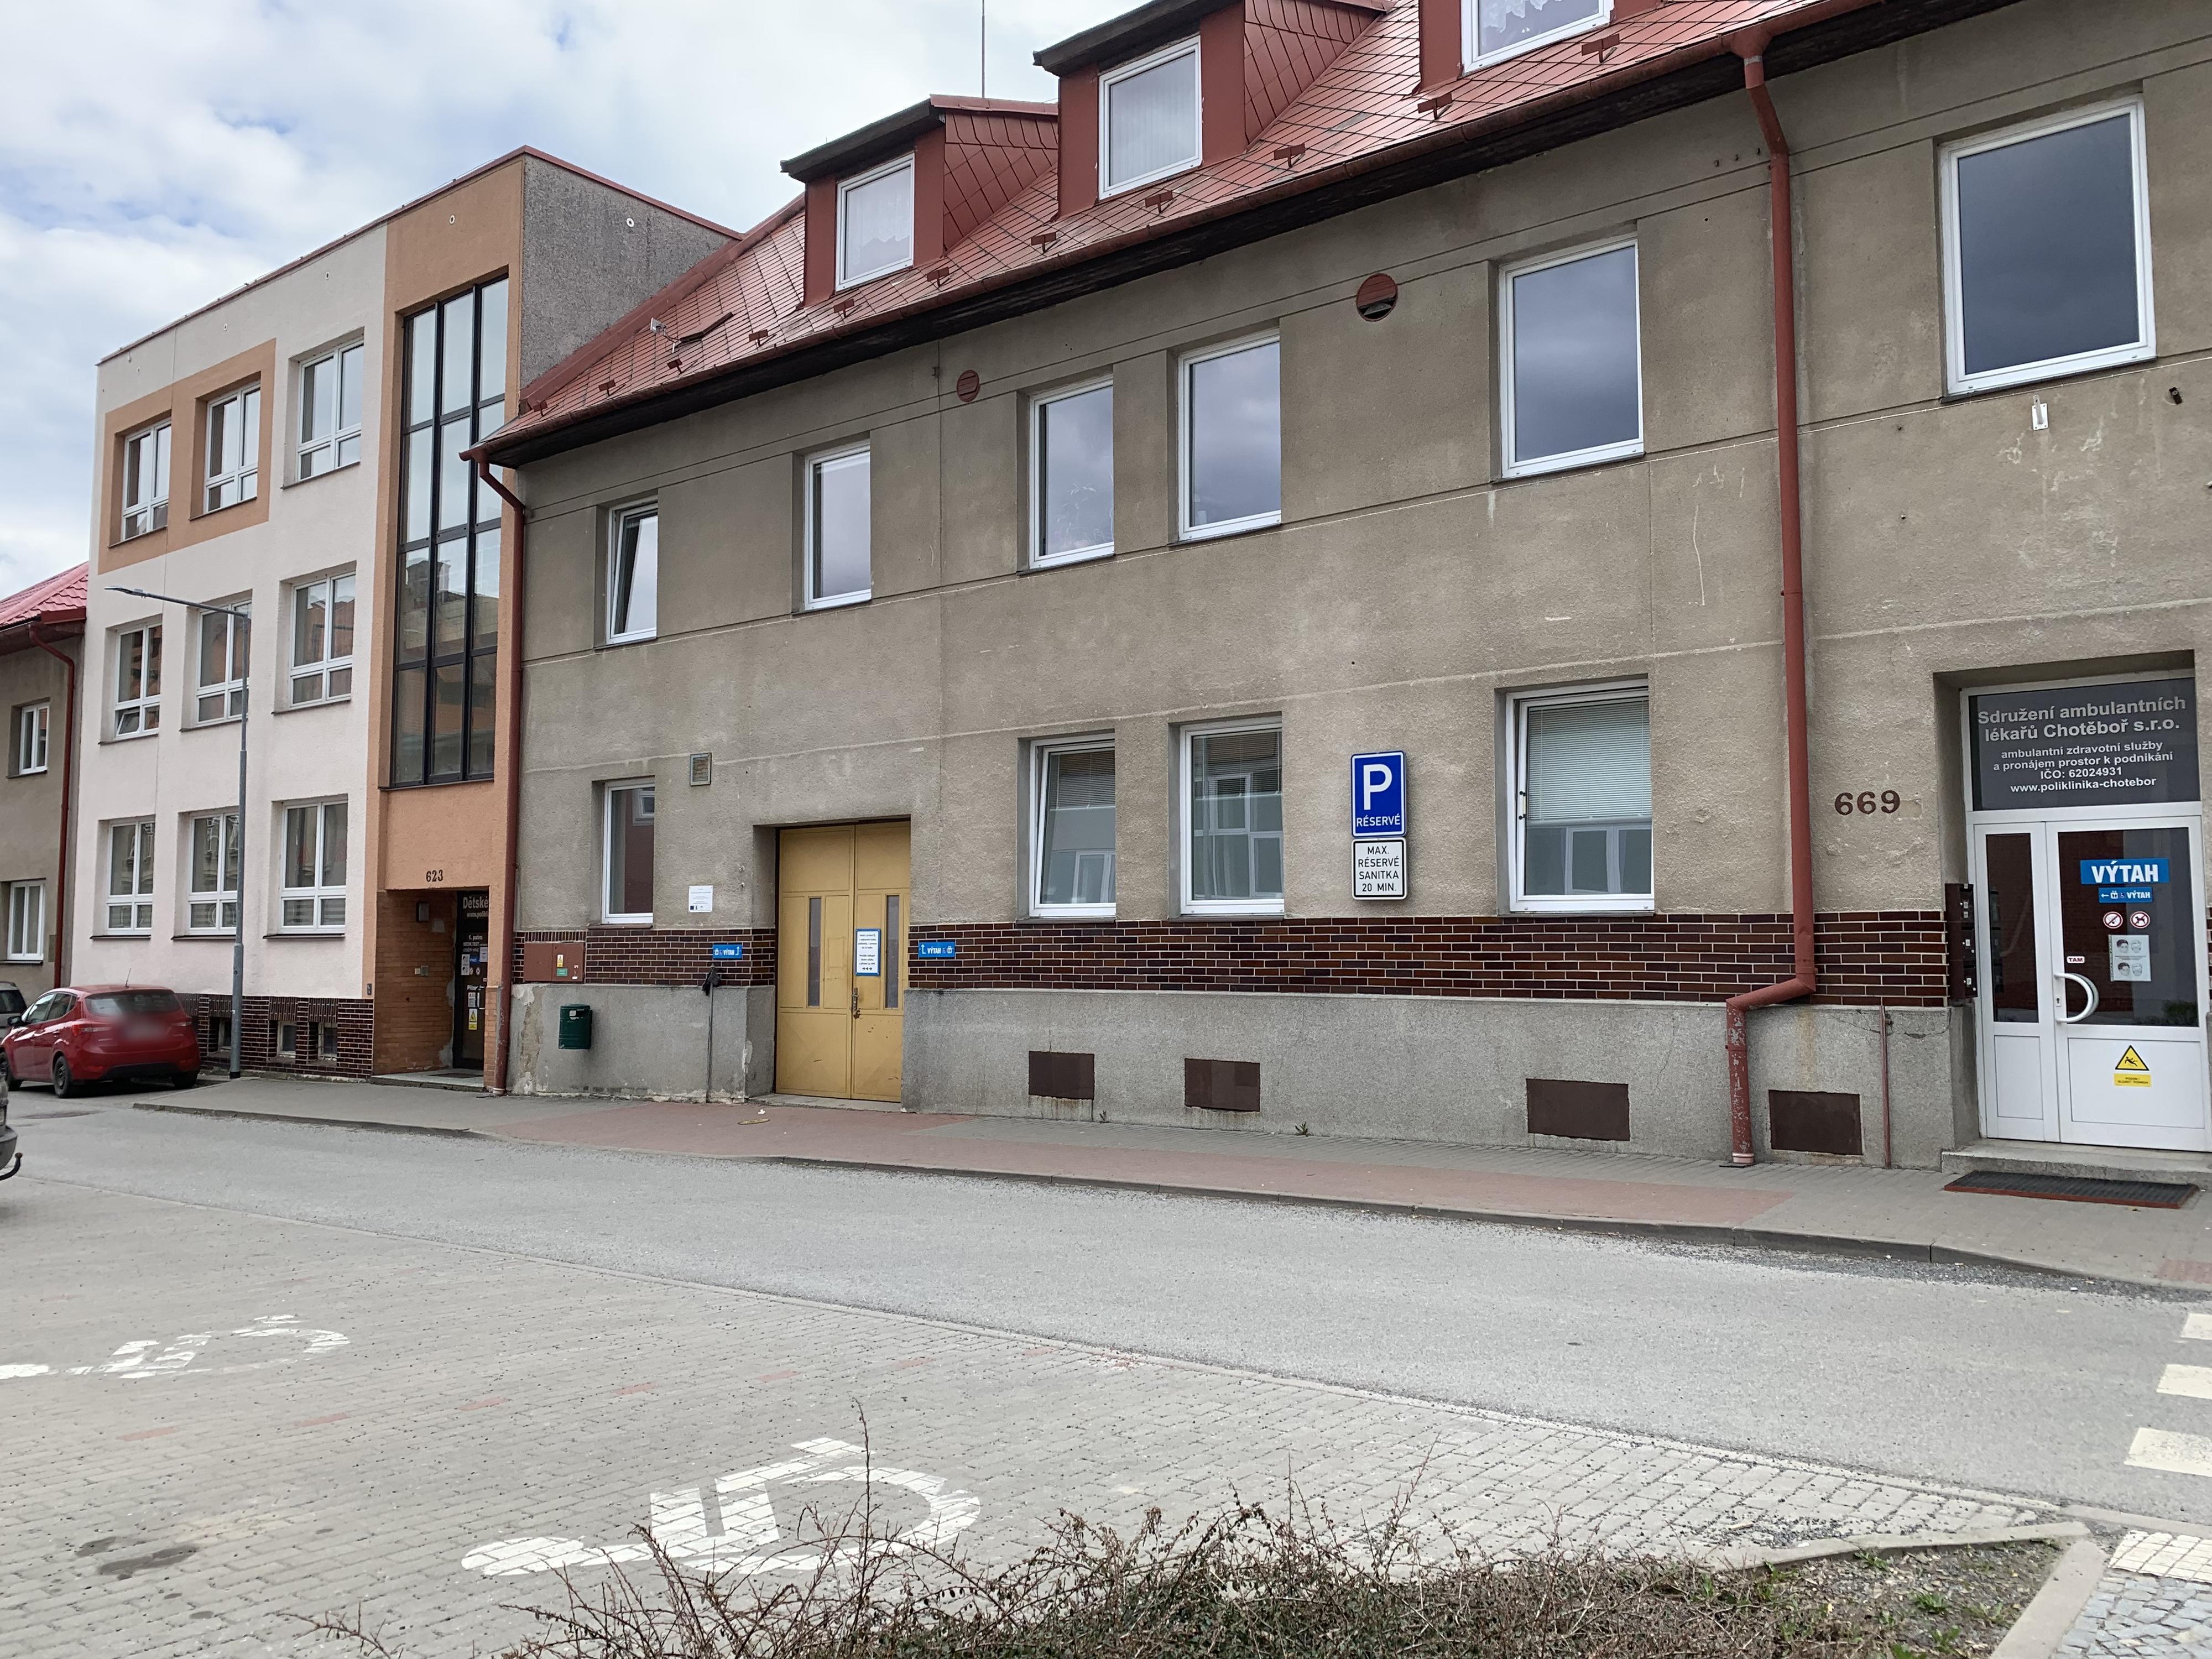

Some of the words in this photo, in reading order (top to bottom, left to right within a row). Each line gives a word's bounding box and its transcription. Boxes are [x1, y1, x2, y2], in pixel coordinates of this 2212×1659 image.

[1978, 706, 2056, 724] Sdružení
[2059, 696, 2186, 718] ambulantních
[1985, 725, 2038, 742] lékařů
[2044, 719, 2128, 738] Chotěboř
[2133, 718, 2180, 732] s.r.o.
[2001, 747, 2064, 759] ambulantní
[2067, 743, 2120, 755] zdravotní
[2124, 741, 2163, 752] služby
[2003, 759, 2055, 772] pronájem
[2059, 758, 2100, 769] prostor
[2104, 755, 2111, 764] k
[2114, 752, 2173, 765] podnikání
[2041, 769, 2065, 780] IČO:
[2068, 766, 2122, 778] 62024931
[1363, 764, 1392, 810] P
[2010, 778, 2157, 793] www.poliklinika-chotebor
[1834, 790, 1900, 816] 669
[1357, 813, 1401, 827] RÉSERVÉ
[1367, 846, 1390, 855] MAX.
[1358, 856, 1400, 868] RÉSERVÉ
[426, 869, 444, 882] 623
[1359, 870, 1399, 880] SANITKA
[2091, 860, 2159, 883] VÝTAH
[1362, 883, 1373, 893] 20
[1377, 883, 1397, 892] MIN.
[2126, 890, 2151, 899] VÝTAH
[462, 896, 488, 909] Dětské
[927, 946, 942, 954] VÝTAH
